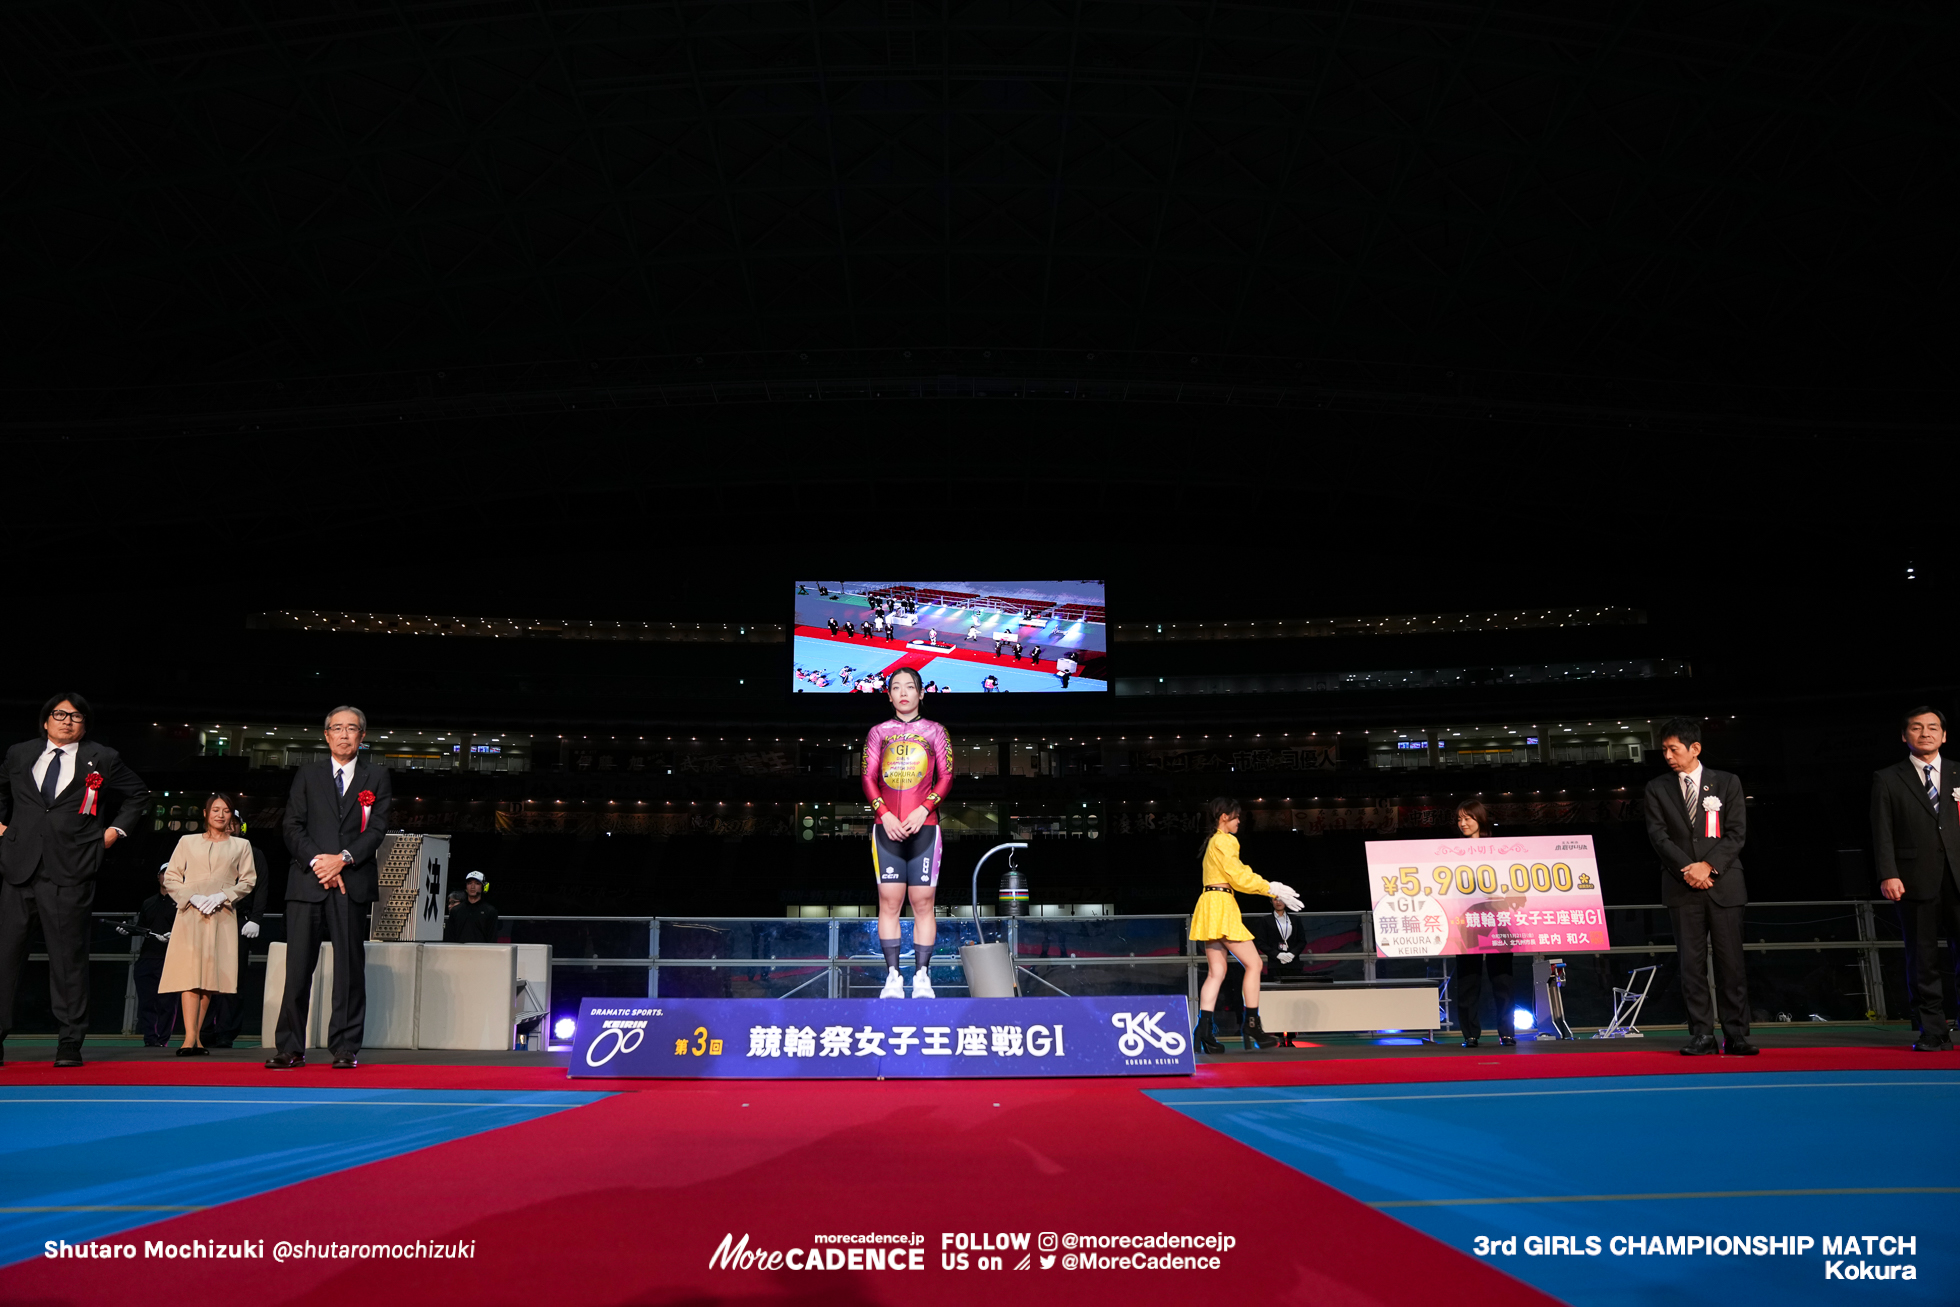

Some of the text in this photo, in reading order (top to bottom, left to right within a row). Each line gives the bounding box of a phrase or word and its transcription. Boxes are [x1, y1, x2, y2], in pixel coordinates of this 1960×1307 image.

[1467, 845, 1496, 856] 小切手
[1382, 862, 1574, 897] ¥5,900,000
[1379, 915, 1444, 934] 競輪祭
[1465, 911, 1512, 928] 競輪祭
[1392, 936, 1432, 946] KOKURA
[1538, 933, 1561, 945] 武内
[1566, 932, 1590, 944] 和久
[1398, 946, 1428, 955] KEIRIN
[590, 1008, 630, 1016] DRAMATIC
[602, 1020, 648, 1029] KEIRIN
[674, 1024, 1066, 1058] 第3回 競輪祭女子王座戦GI
